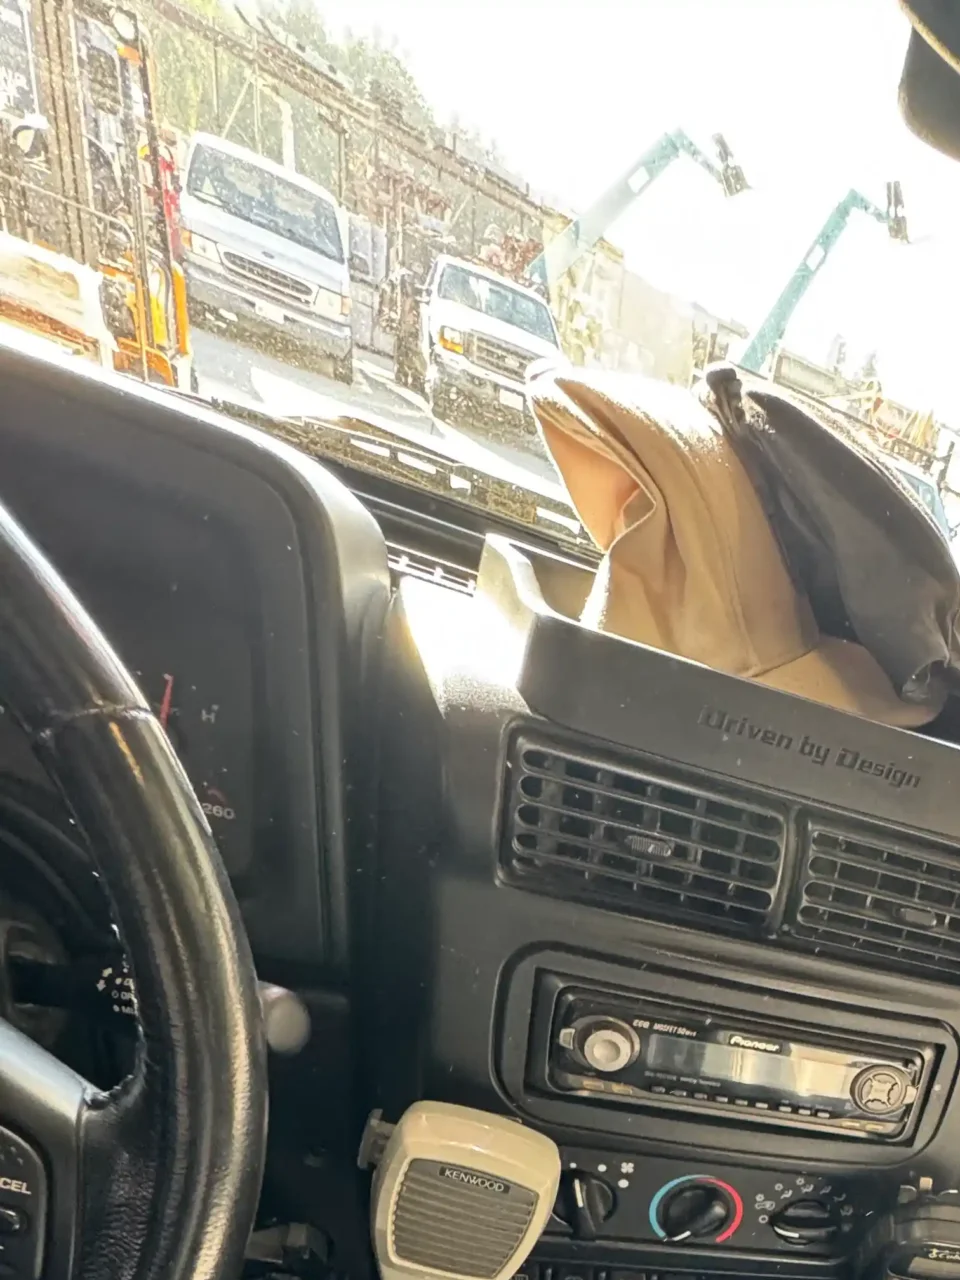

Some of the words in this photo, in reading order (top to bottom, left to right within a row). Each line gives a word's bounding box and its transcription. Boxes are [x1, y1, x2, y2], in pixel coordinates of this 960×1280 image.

[698, 706, 793, 750] Driven
[799, 736, 831, 766] by
[835, 747, 921, 788] Design
[201, 803, 235, 820] 260
[730, 1035, 780, 1051] Pioneer
[444, 1168, 504, 1192] KENWOOD
